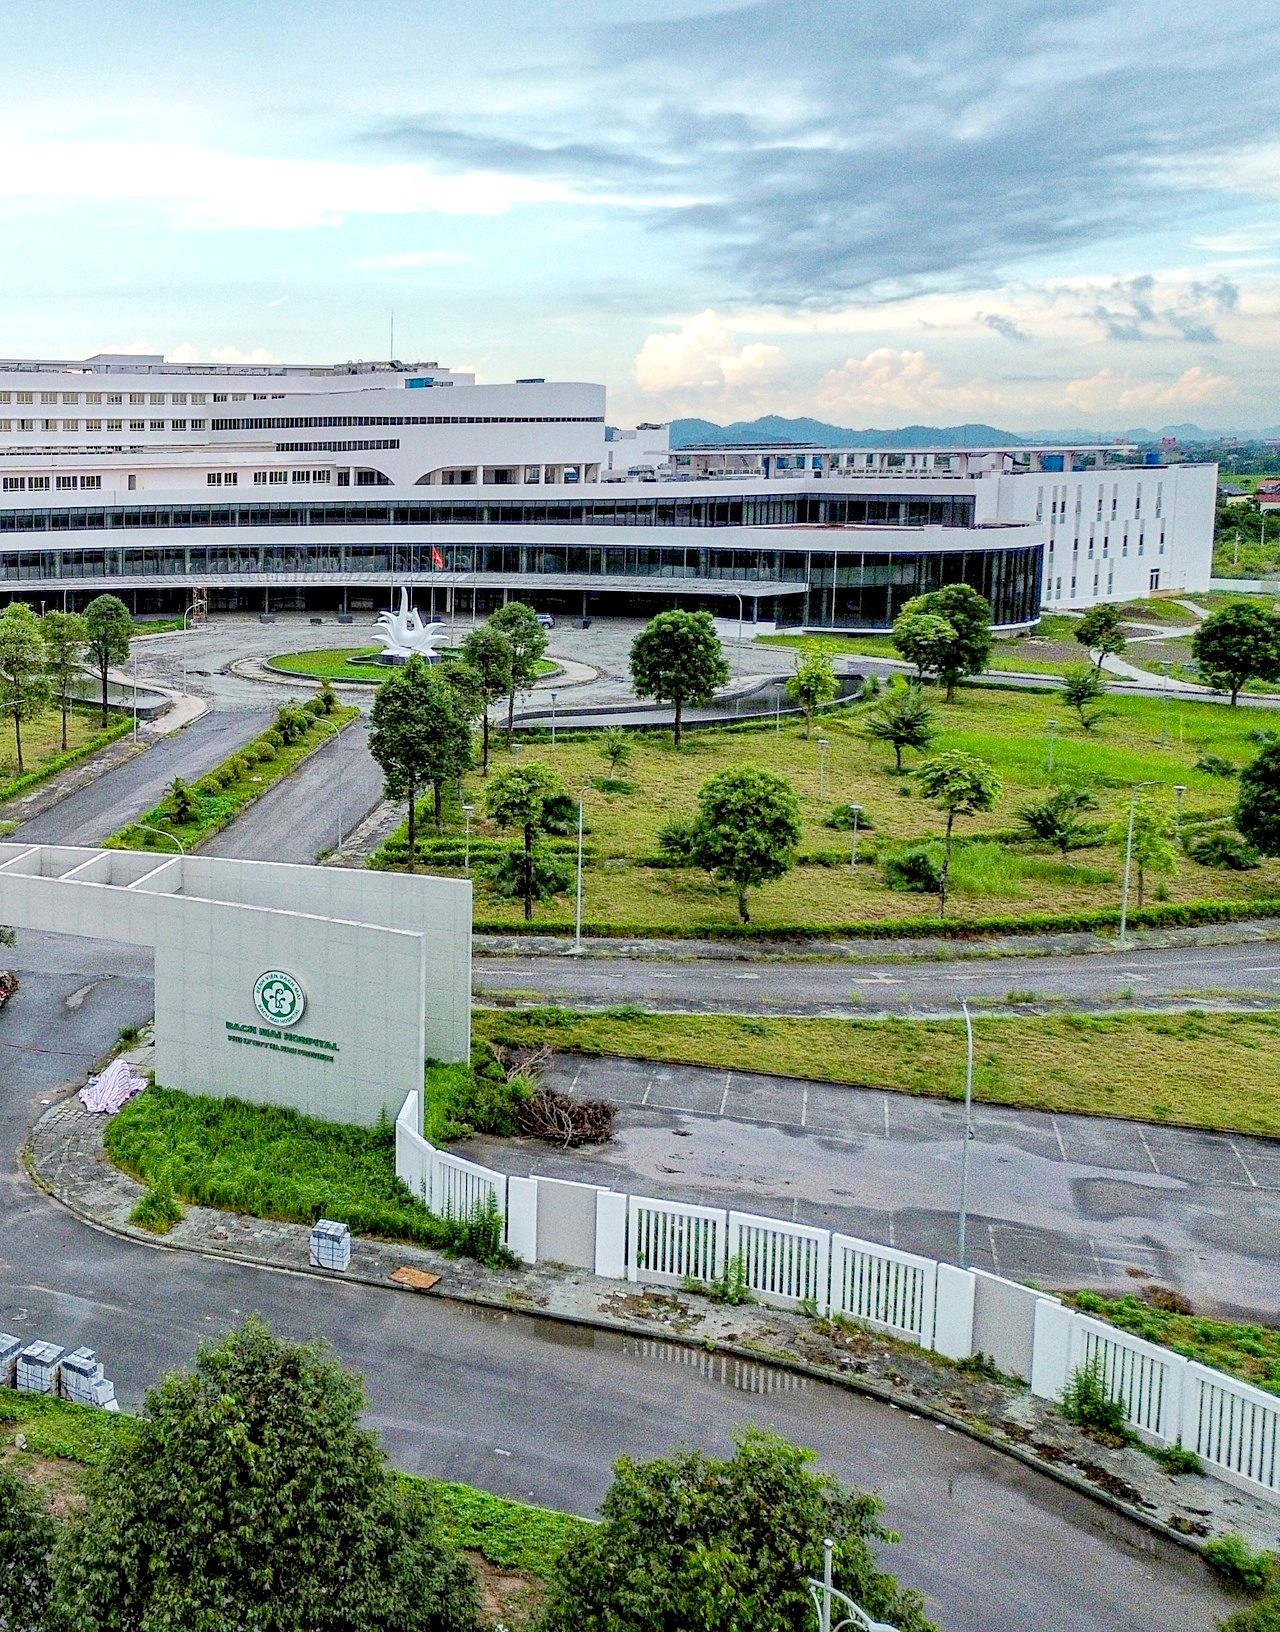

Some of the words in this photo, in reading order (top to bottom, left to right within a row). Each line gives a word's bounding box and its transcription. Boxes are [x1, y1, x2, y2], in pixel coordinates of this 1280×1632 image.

[225, 1020, 257, 1034] BACH
[259, 1027, 282, 1040] MAI
[284, 1032, 340, 1052] HOSPITAL
